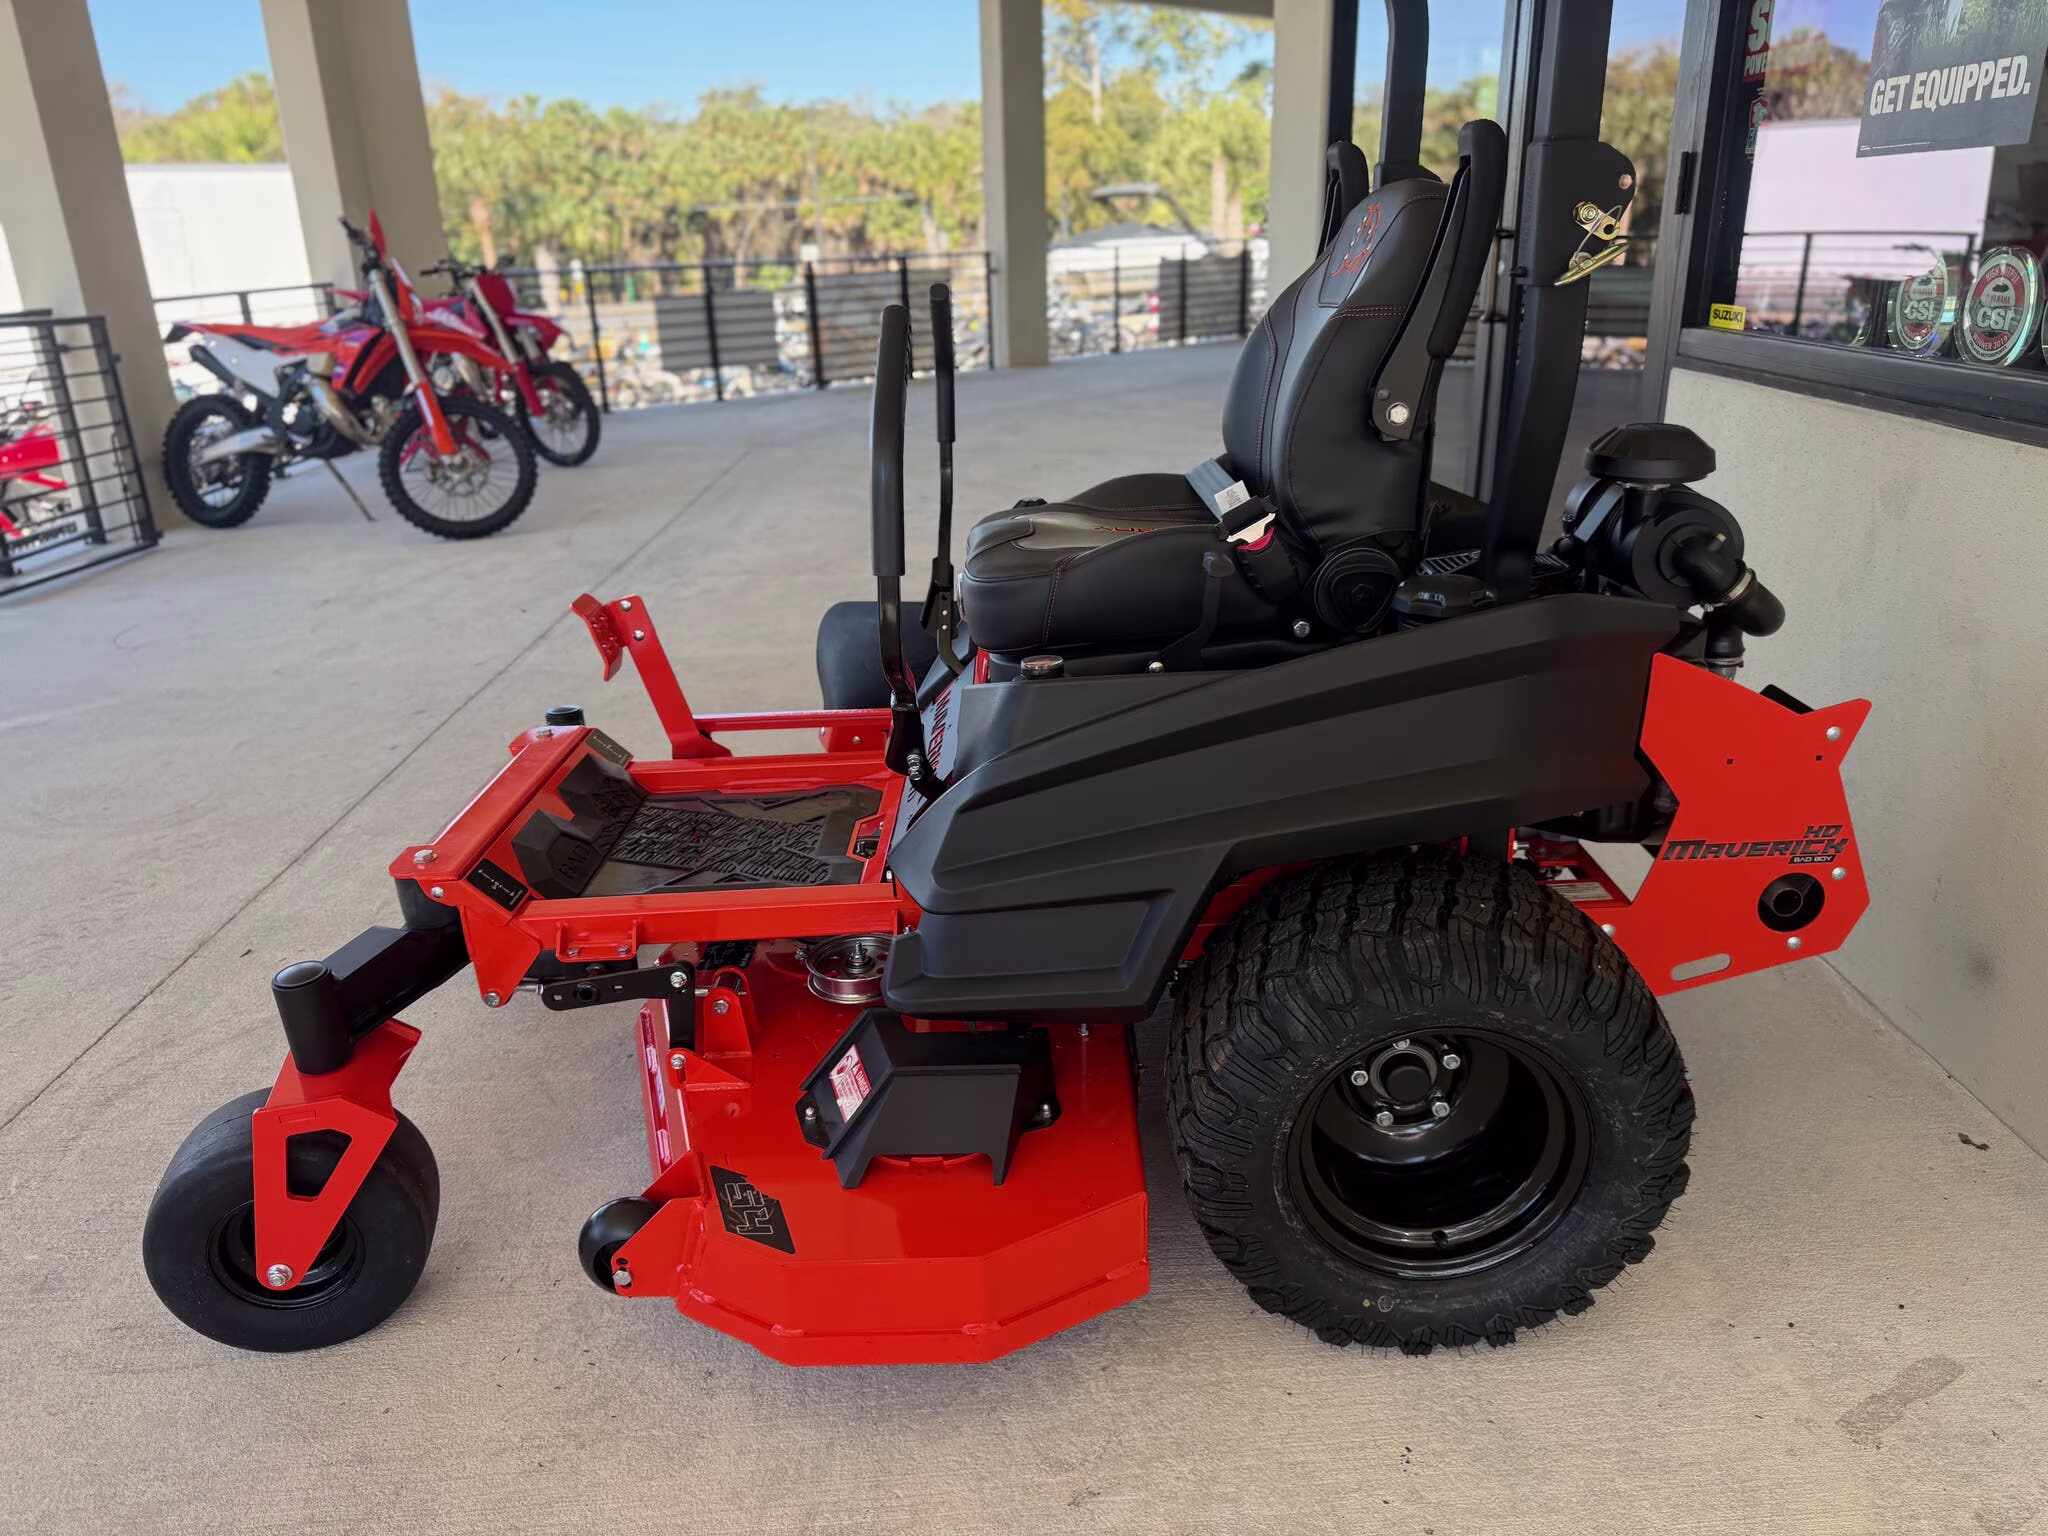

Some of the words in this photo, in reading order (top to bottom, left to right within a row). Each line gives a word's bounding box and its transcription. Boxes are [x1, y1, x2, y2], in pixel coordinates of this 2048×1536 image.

[1870, 74, 1911, 116] GET
[1910, 54, 2032, 113] EQUIPPED.
[1712, 308, 1744, 322] SUZUKI
[1804, 825, 1844, 839] HD
[1661, 837, 1849, 861] MAVERICK
